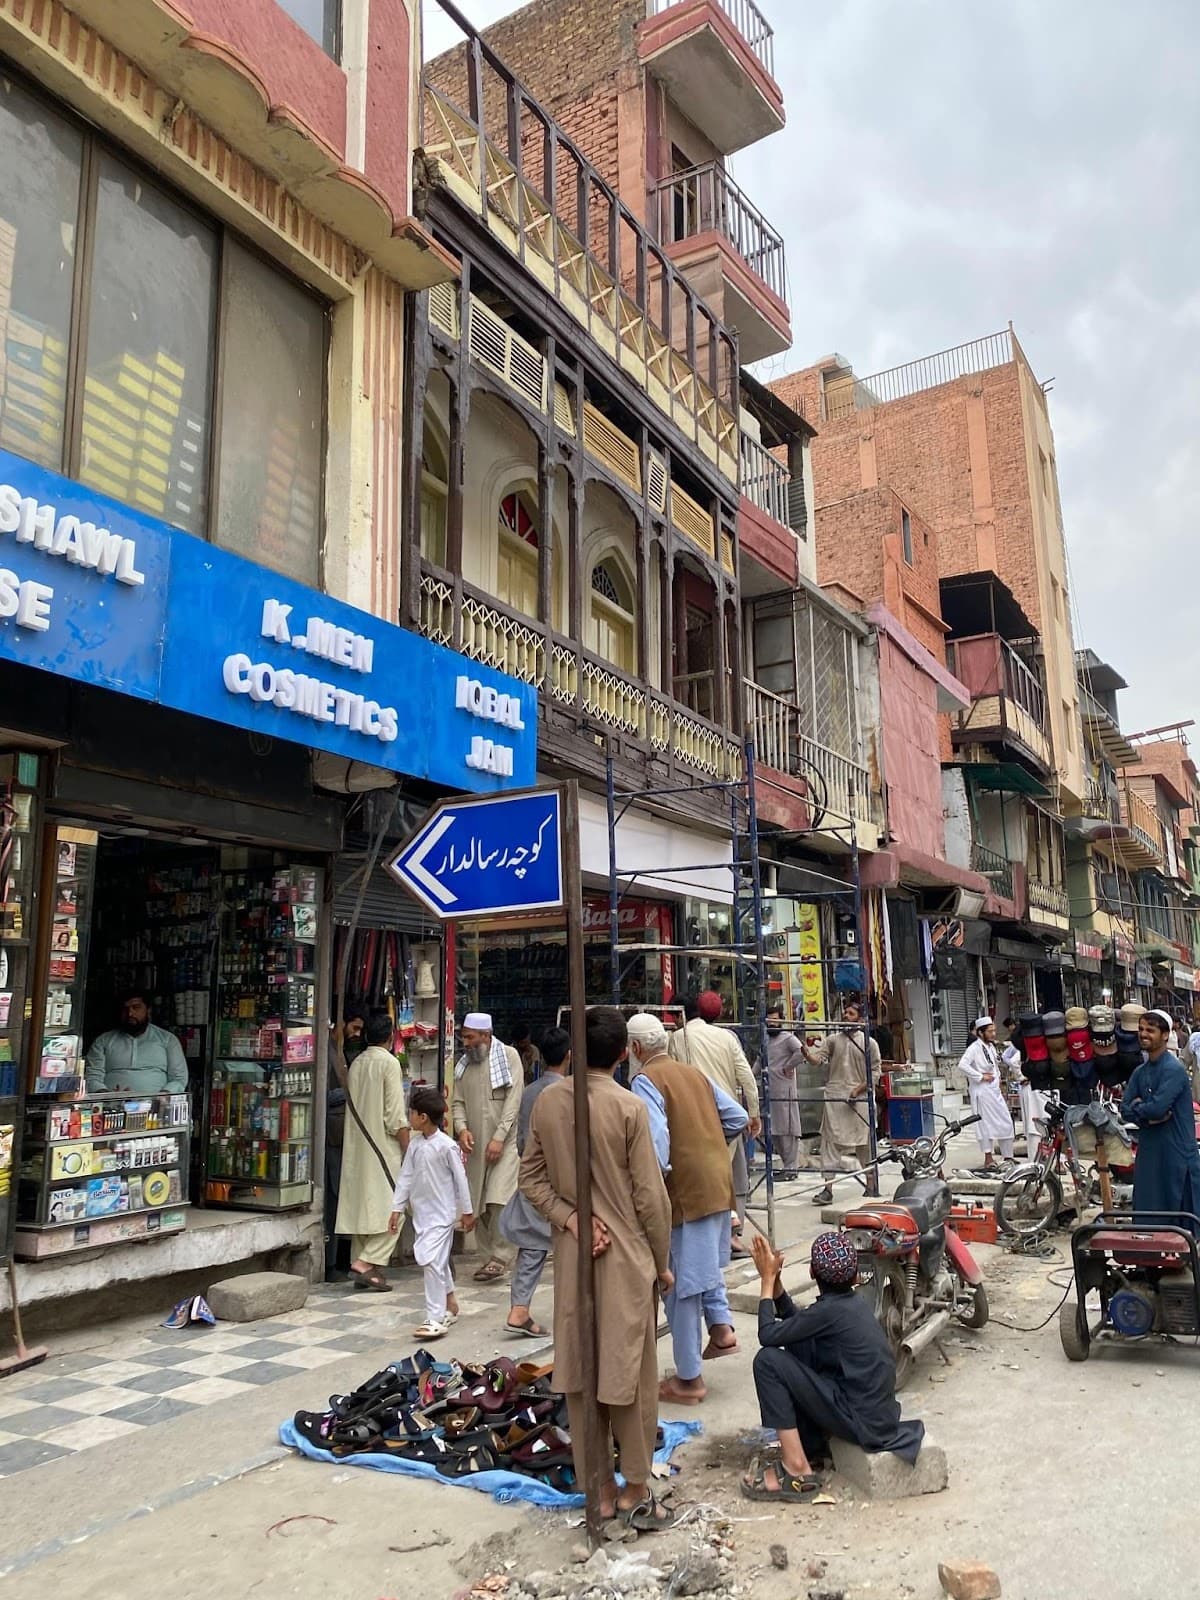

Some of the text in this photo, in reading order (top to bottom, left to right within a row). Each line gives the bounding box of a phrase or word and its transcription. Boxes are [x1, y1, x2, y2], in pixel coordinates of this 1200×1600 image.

[0, 484, 145, 586] SHAWL
[222, 653, 398, 742] COSMETICS
[455, 675, 525, 730] IQBAL
[435, 813, 553, 880] کوچہ رسالدار
